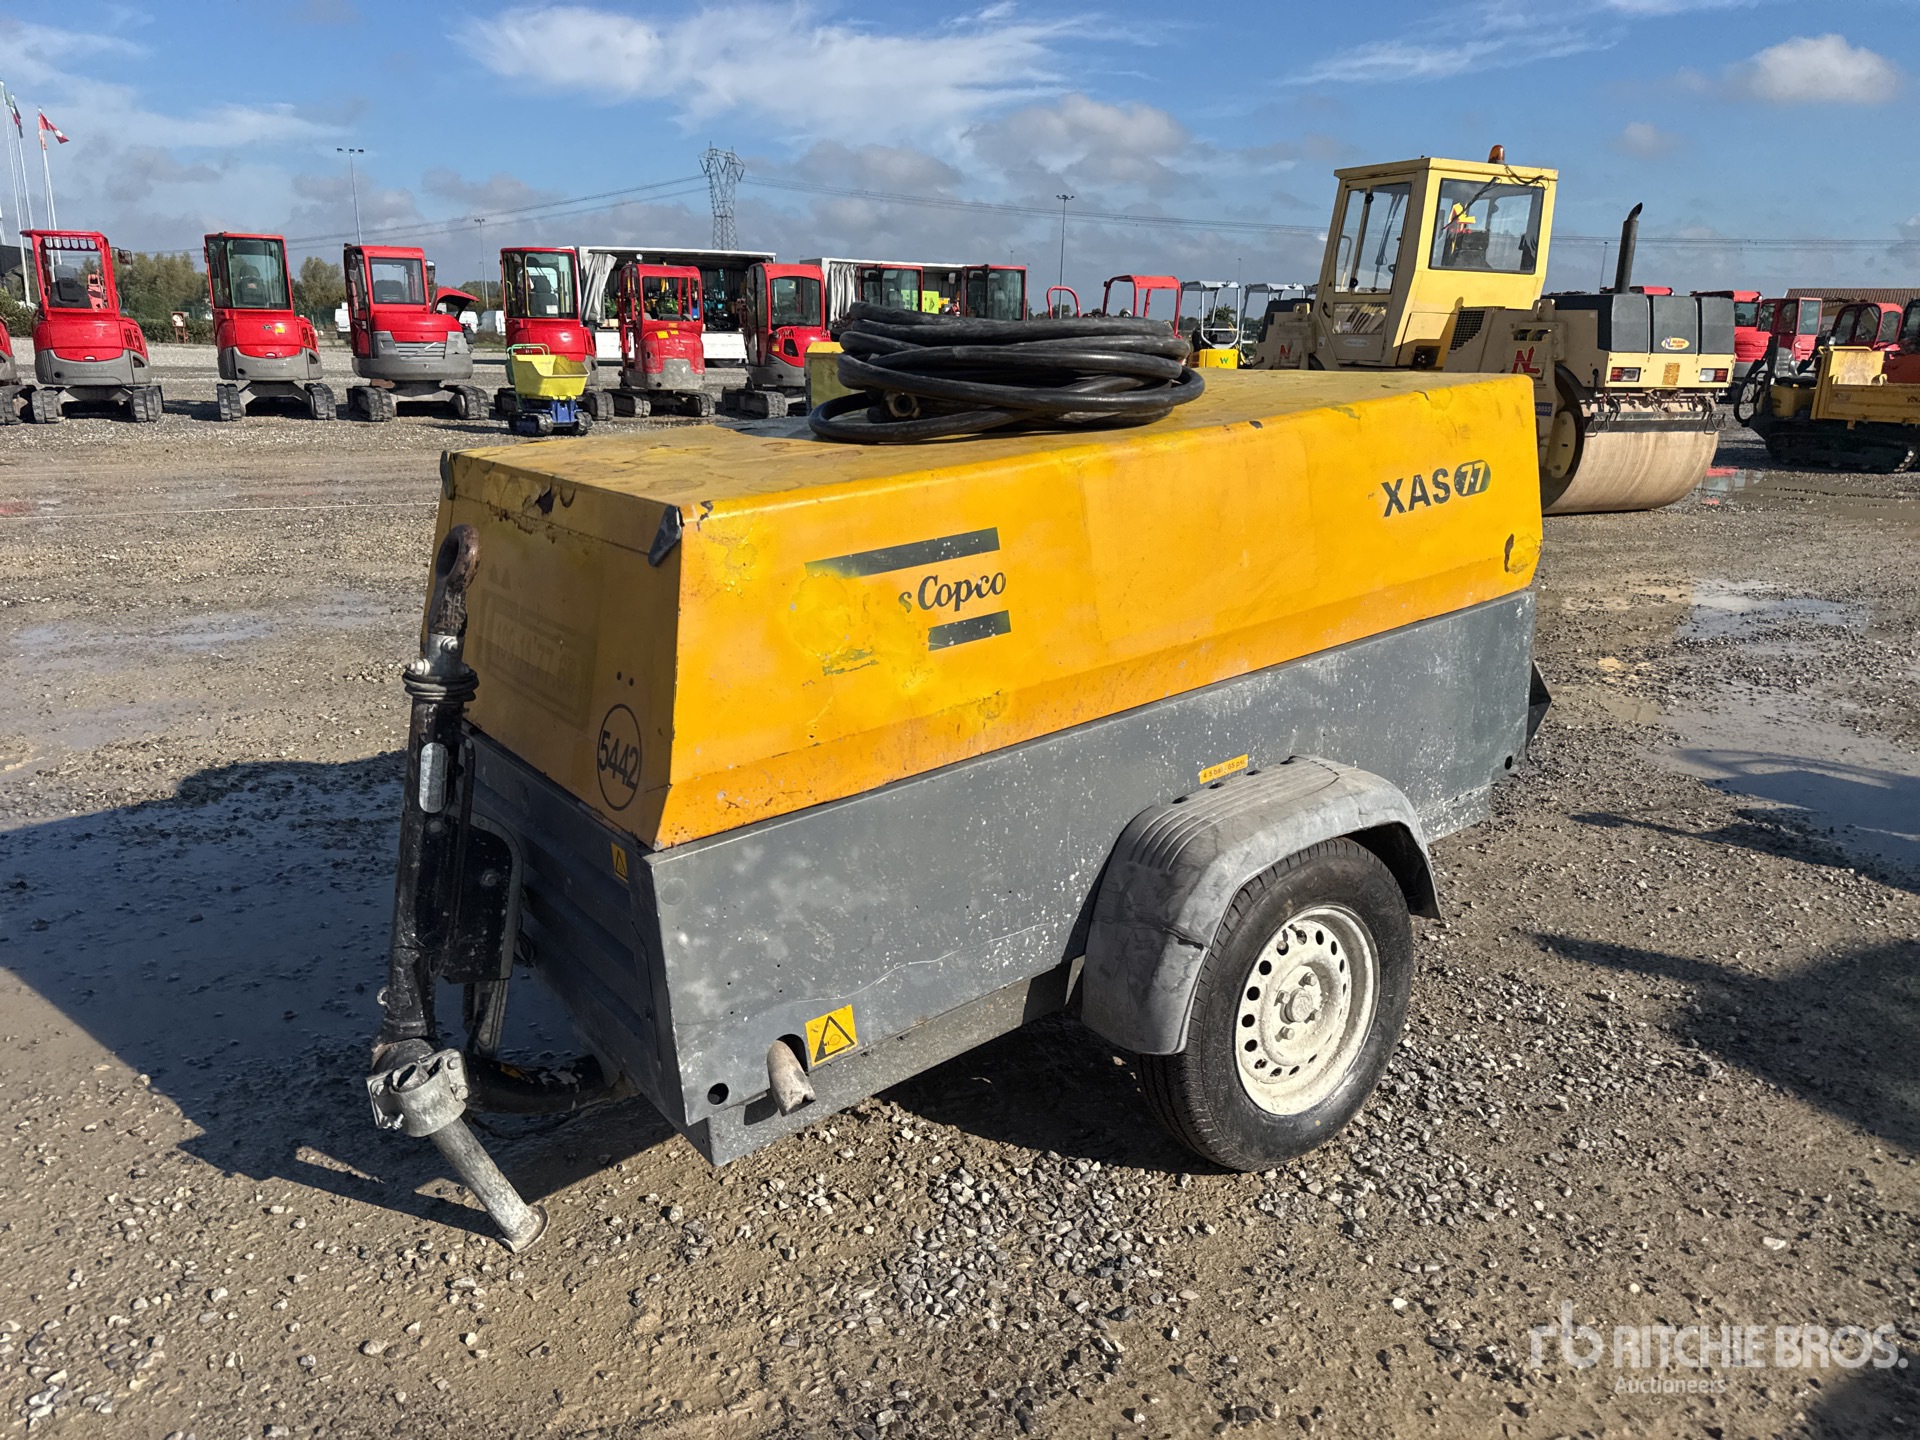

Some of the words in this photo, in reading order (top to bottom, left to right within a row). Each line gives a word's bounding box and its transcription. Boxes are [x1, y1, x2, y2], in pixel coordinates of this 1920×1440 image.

[1381, 467, 1451, 518] XAS
[1460, 461, 1486, 495] 77
[917, 571, 1007, 612] Copco
[598, 729, 639, 791] 5442
